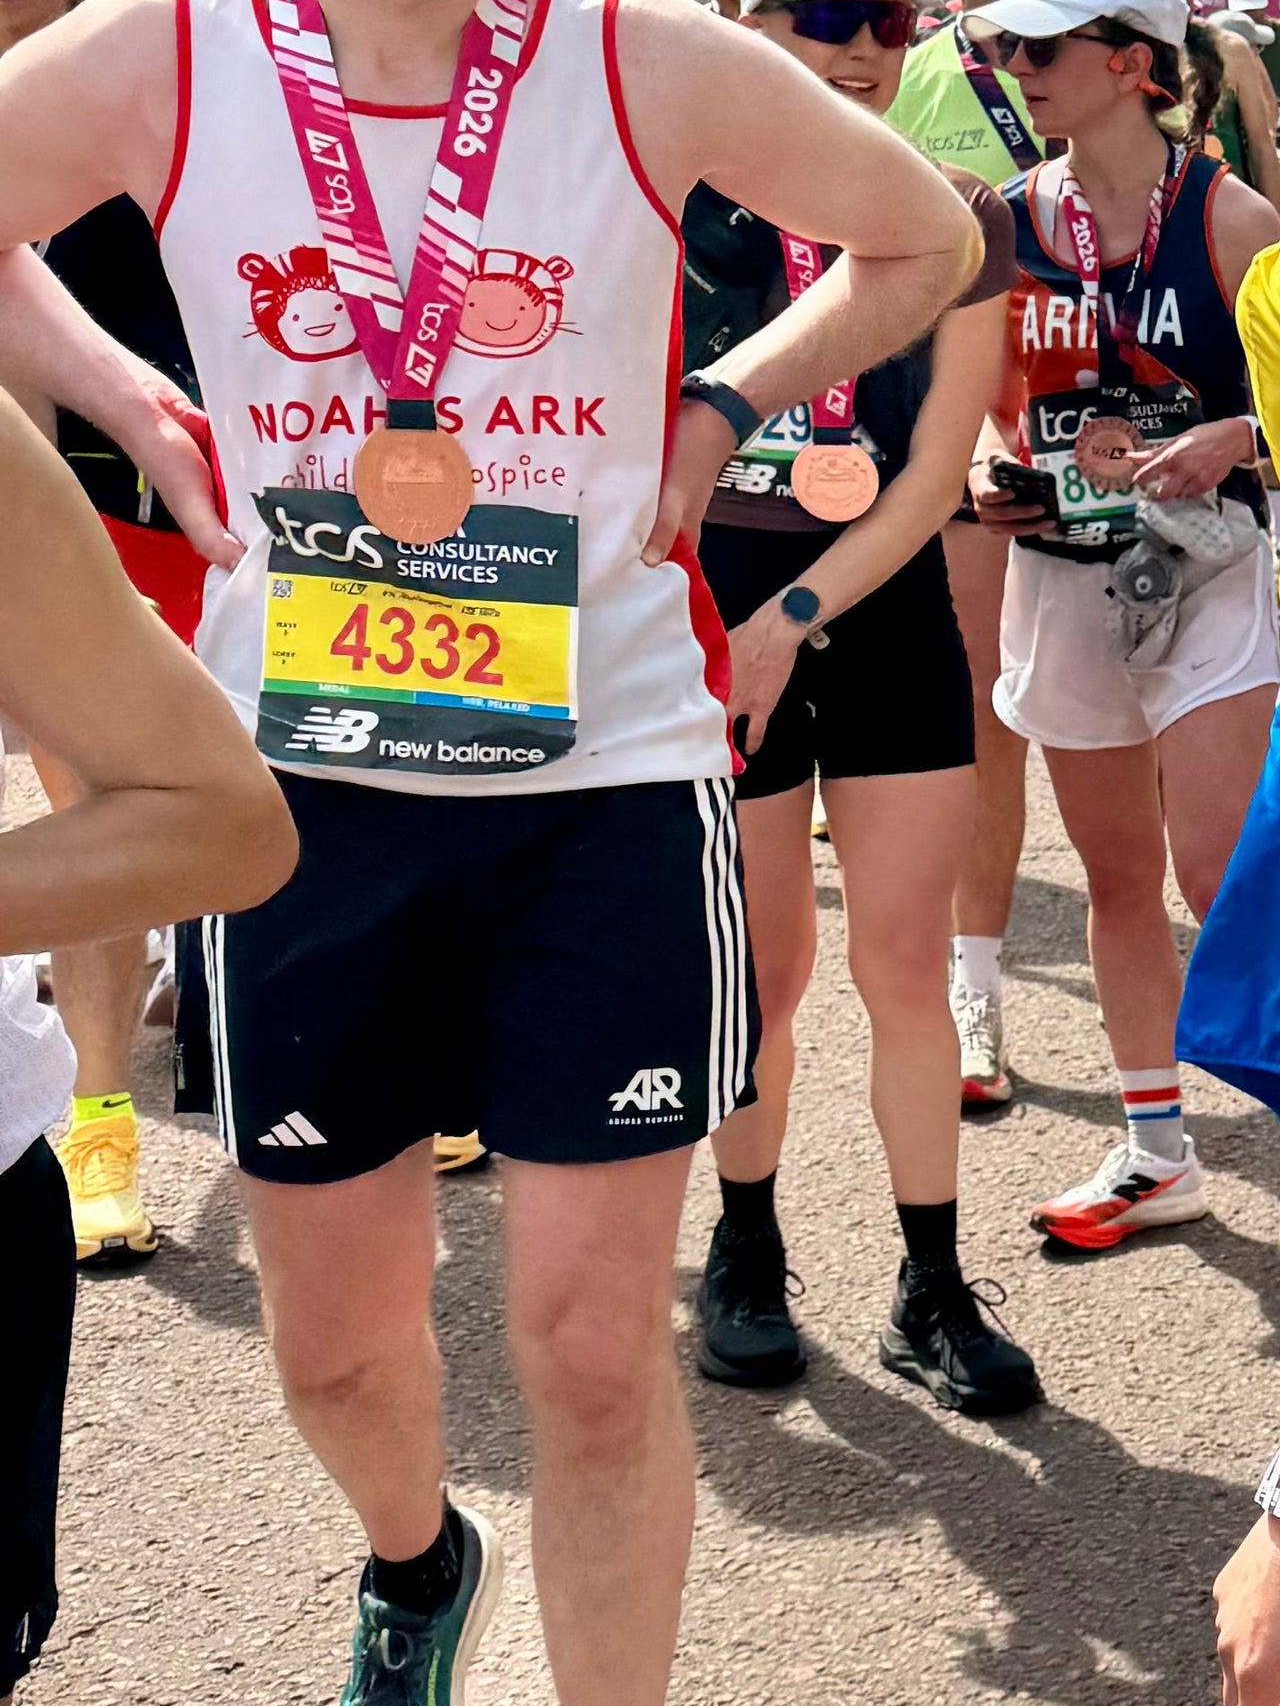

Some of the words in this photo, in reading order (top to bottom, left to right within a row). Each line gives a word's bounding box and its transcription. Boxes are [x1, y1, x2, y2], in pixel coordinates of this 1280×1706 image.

[453, 67, 502, 158] 2026
[1072, 217, 1098, 272] 2026
[247, 394, 464, 443] NOAHS
[484, 394, 607, 437] ARK
[471, 454, 566, 496] ospice
[275, 506, 384, 570] tcs
[396, 543, 559, 567] CONSULTANCY
[396, 559, 499, 585] SERVICES
[329, 603, 504, 687] 4332
[379, 739, 431, 761] new
[437, 741, 546, 764] balance
